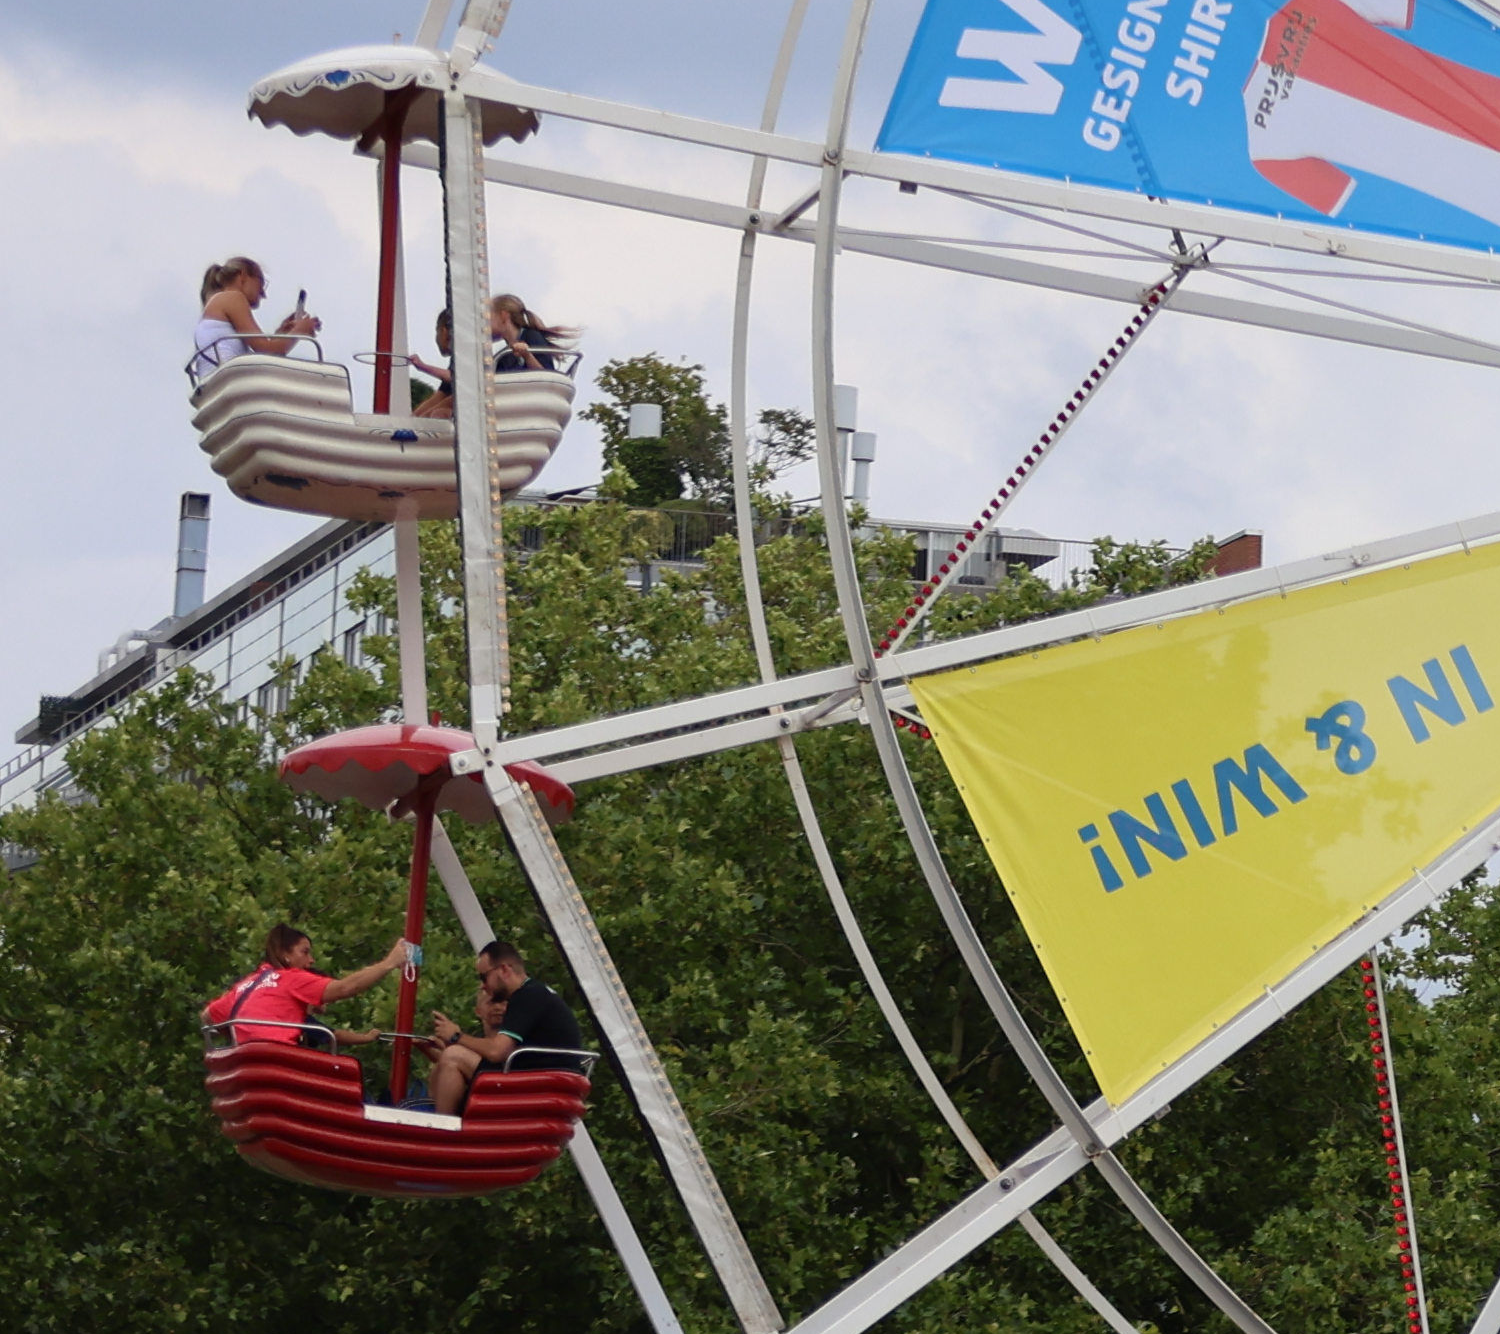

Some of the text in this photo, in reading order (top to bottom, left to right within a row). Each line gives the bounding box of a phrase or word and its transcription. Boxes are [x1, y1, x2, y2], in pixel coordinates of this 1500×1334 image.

[1305, 699, 1378, 776] &
[1385, 644, 1496, 744] IN
[1077, 742, 1310, 894] WIN!
